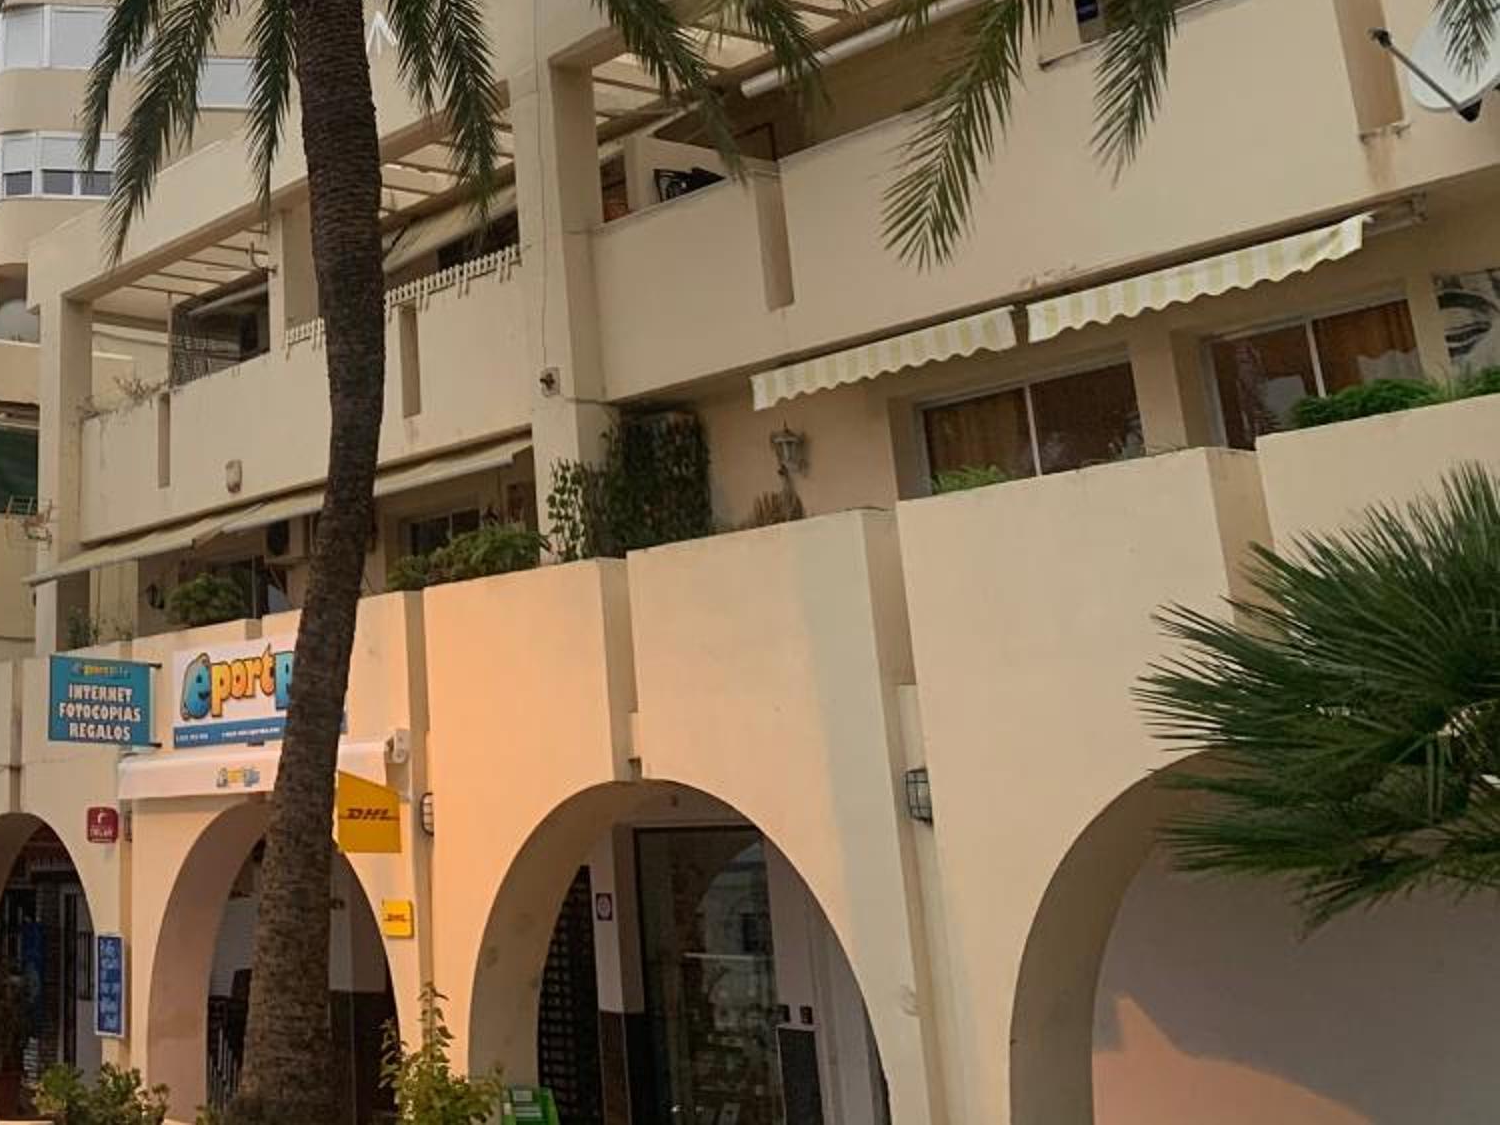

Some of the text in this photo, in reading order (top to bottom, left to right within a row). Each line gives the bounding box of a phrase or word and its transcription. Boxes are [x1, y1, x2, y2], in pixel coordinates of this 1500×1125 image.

[68, 683, 132, 702] INTERNET
[59, 702, 141, 722] FOTOCOPIAS
[69, 722, 131, 741] REGALOS
[346, 807, 390, 821] DHL
